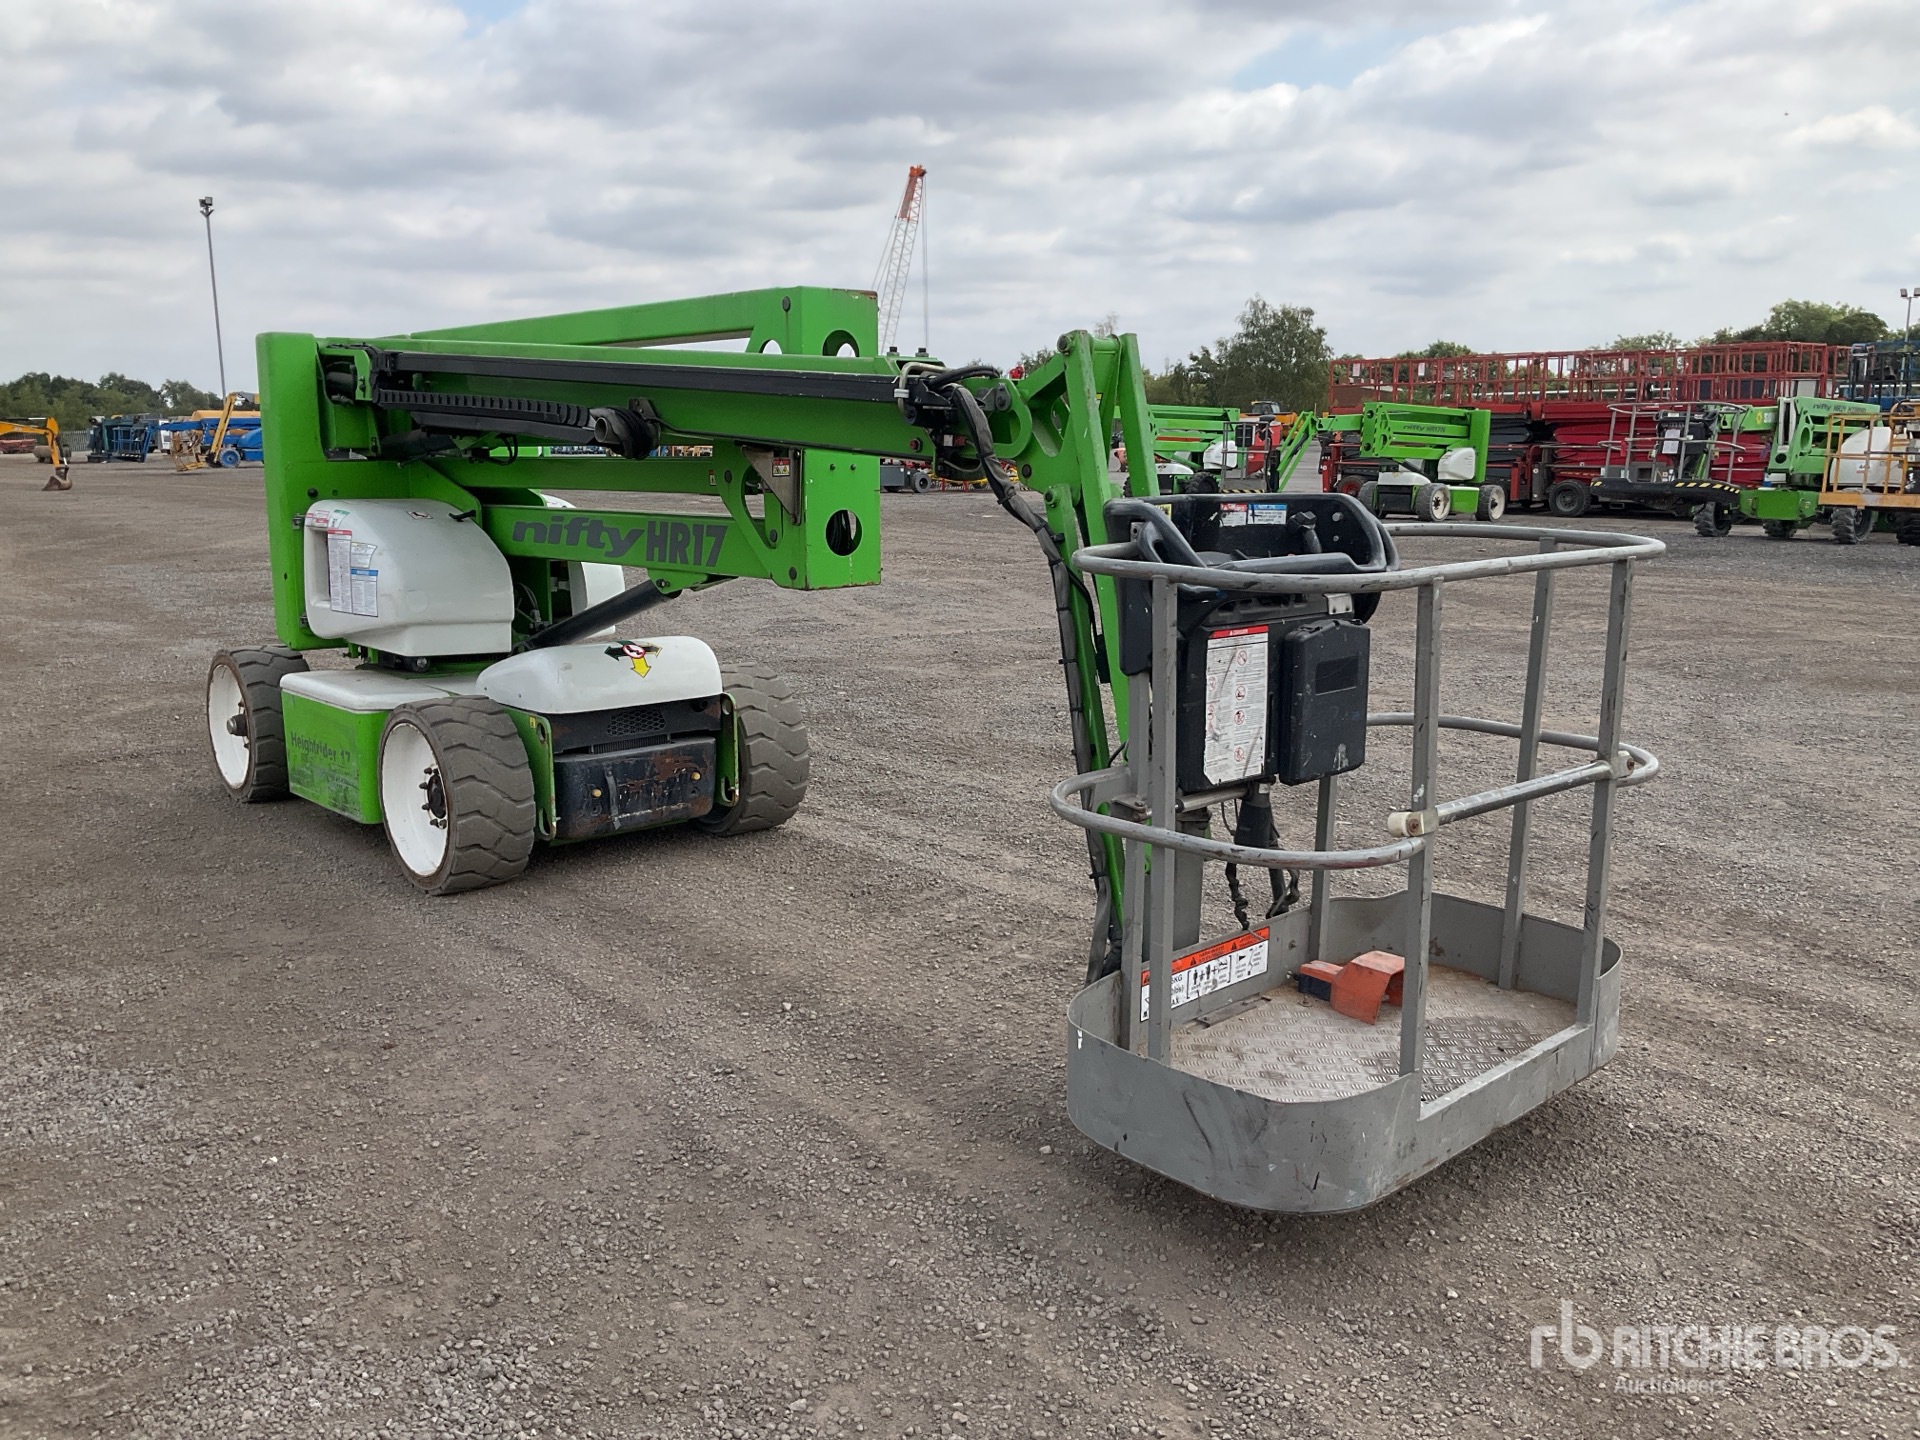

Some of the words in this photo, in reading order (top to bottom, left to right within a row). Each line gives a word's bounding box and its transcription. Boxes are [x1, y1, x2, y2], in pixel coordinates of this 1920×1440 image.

[512, 516, 645, 558] nifty
[645, 521, 728, 567] HR17
[341, 750, 351, 762] 17
